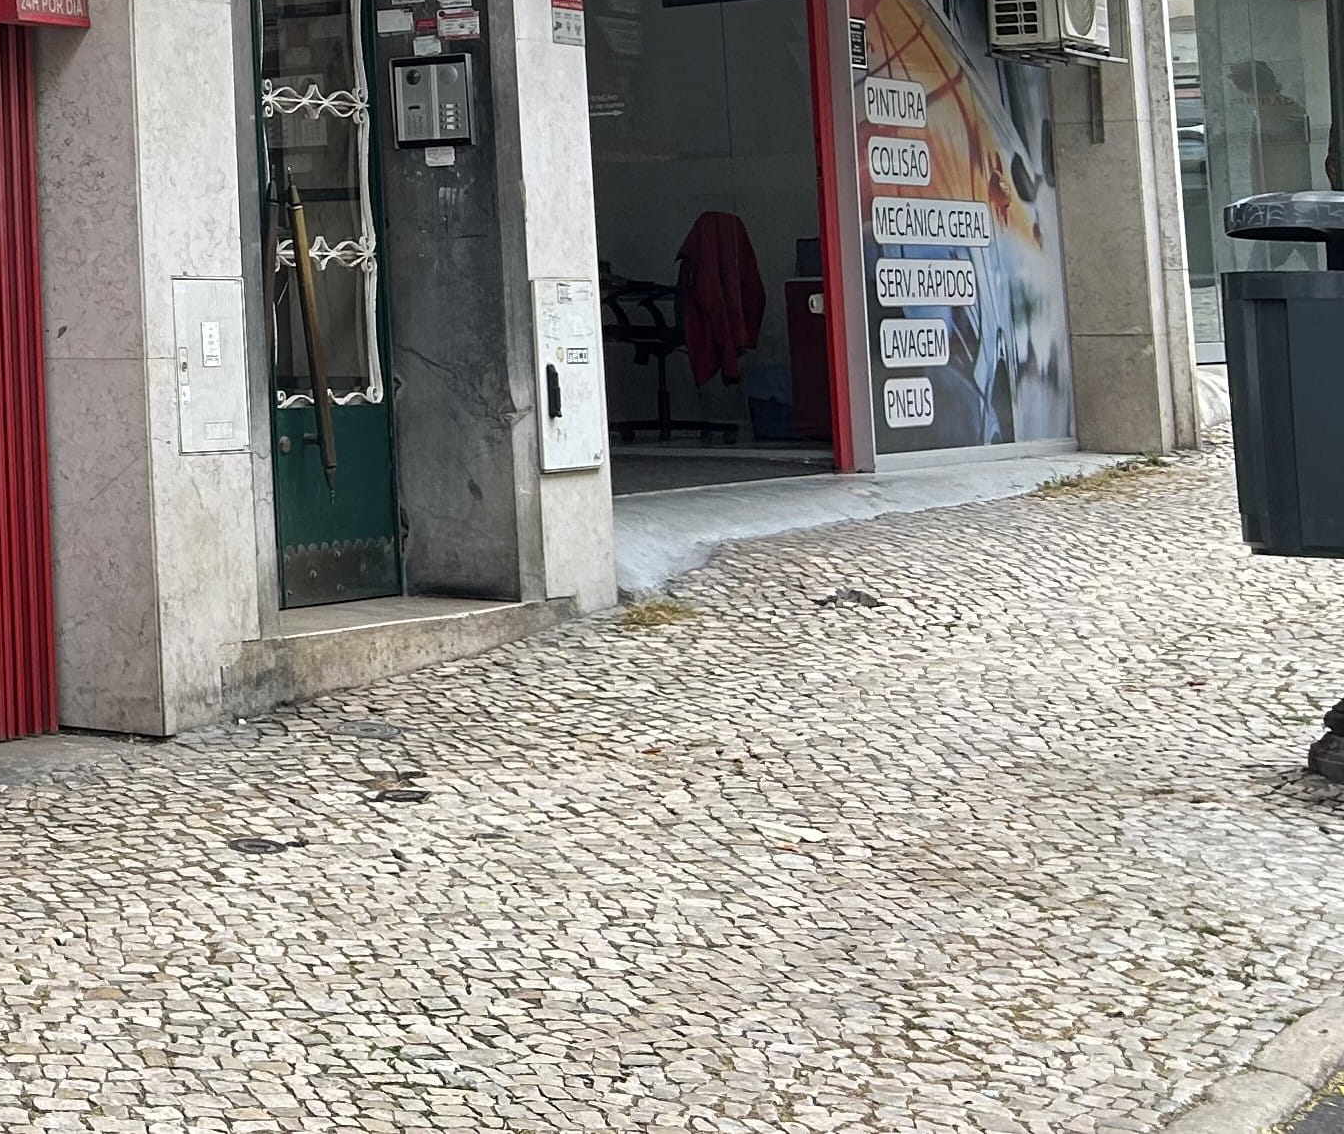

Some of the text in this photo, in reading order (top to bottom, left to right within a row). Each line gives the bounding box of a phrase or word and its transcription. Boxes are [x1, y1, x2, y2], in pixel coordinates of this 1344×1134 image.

[65, 0, 83, 16] DIA
[868, 86, 925, 123] PINTURA
[870, 140, 929, 179] COLISÃO
[874, 200, 990, 240] MECÂNICA GERAL
[878, 262, 974, 300] SERV. RÁPIDOS
[883, 327, 947, 360] LAVAGEM
[887, 388, 933, 420] PNEUS
